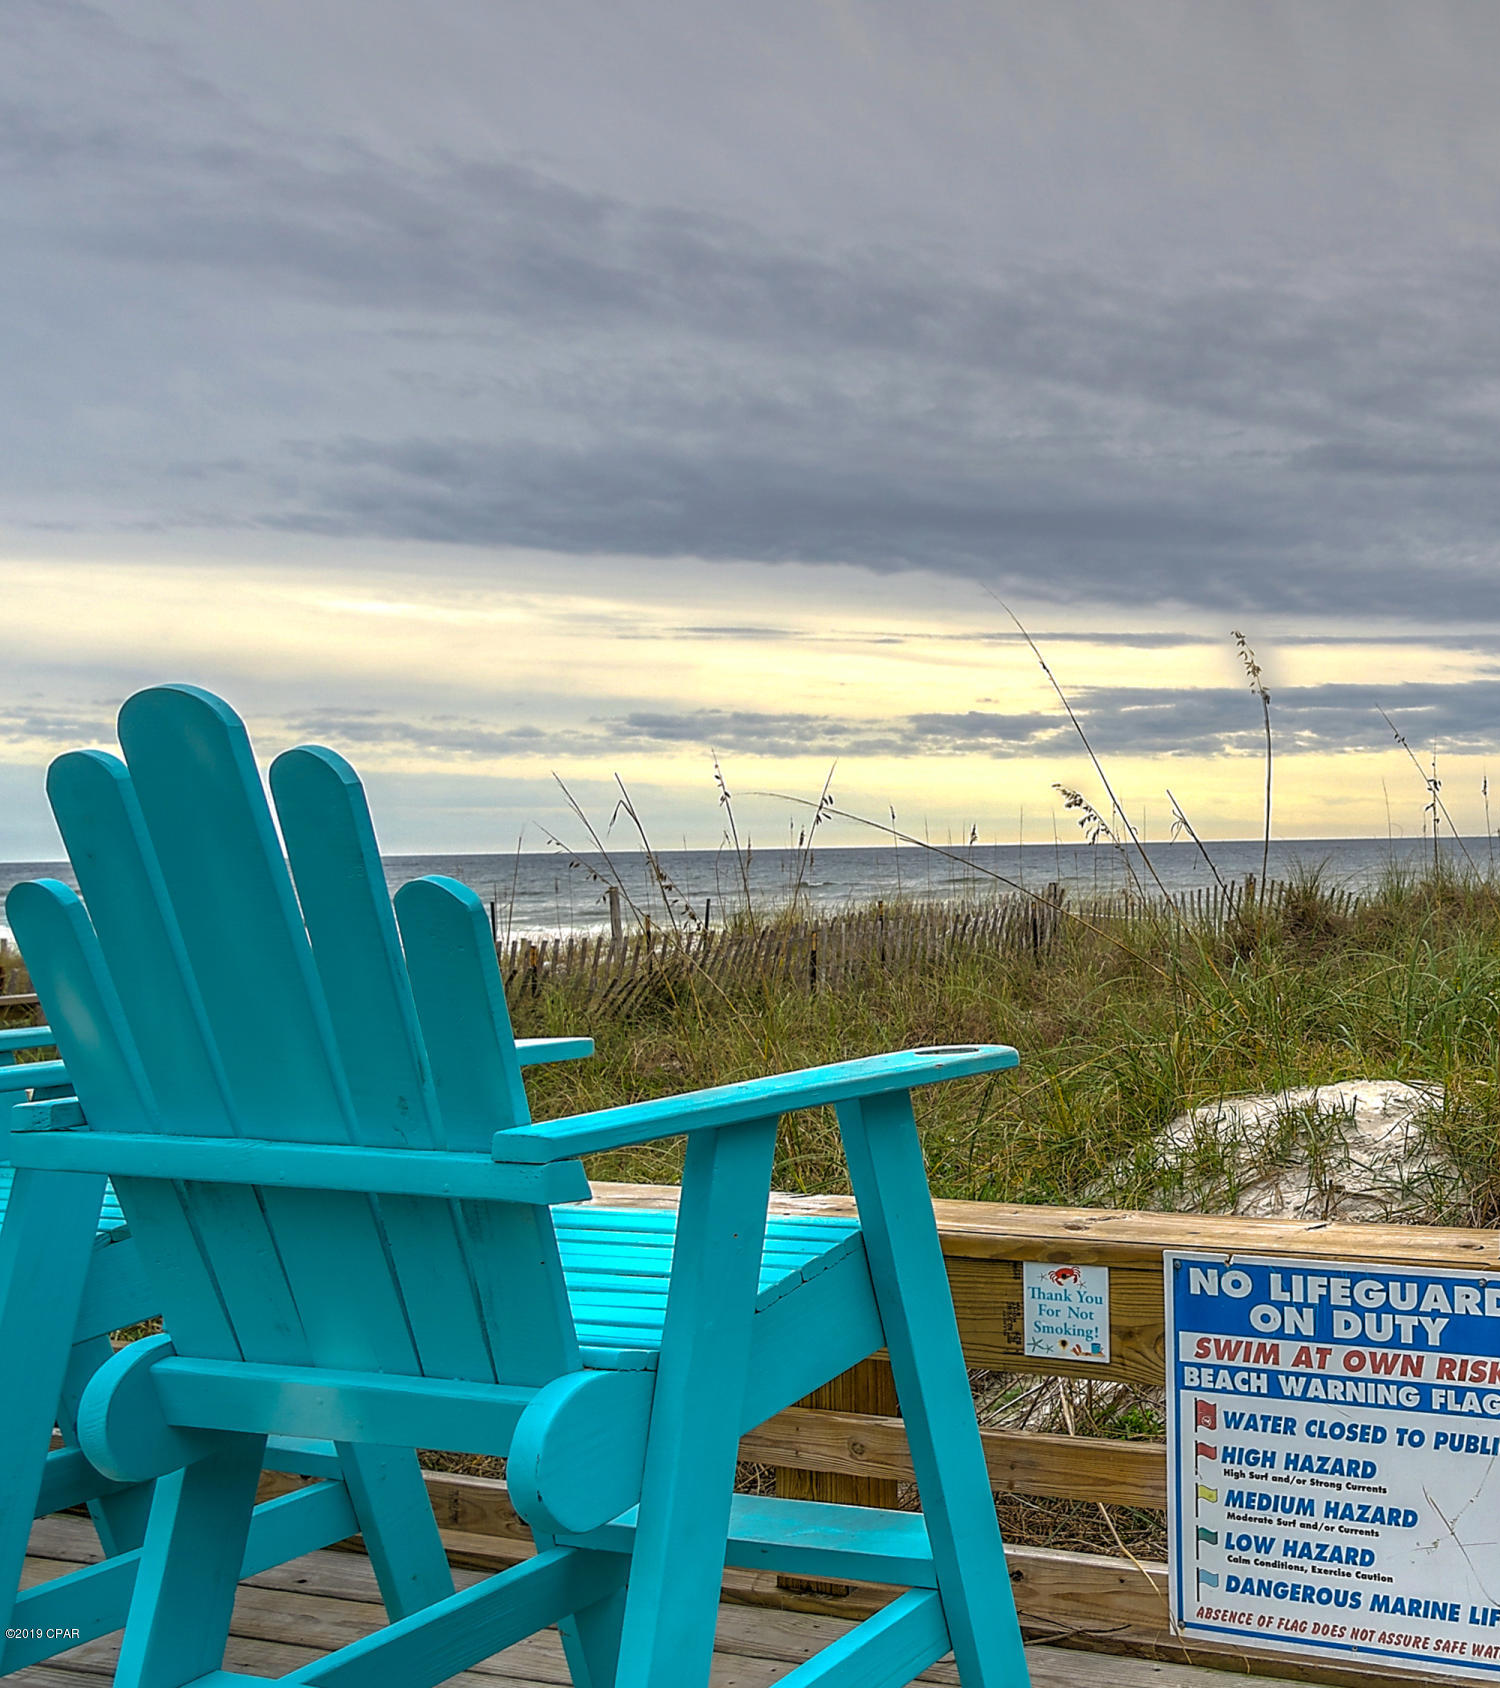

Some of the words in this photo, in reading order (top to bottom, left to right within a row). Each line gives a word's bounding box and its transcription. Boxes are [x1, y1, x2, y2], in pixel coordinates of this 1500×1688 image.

[1027, 1286, 1073, 1303] Thank
[1076, 1290, 1103, 1305] You
[1189, 1267, 1253, 1299] NO
[1038, 1304, 1061, 1317] For
[1067, 1306, 1094, 1321] Not
[1250, 1304, 1314, 1336] ON
[1333, 1310, 1450, 1346] DUTY
[1033, 1320, 1099, 1342] Smoking!
[1194, 1337, 1280, 1366] SWIM
[1291, 1346, 1333, 1370] AT
[1343, 1350, 1425, 1378] OWN
[1184, 1366, 1268, 1394] BEACH
[1278, 1374, 1421, 1408] WARNING
[1223, 1410, 1297, 1436] WATER
[1305, 1419, 1387, 1445] CLOSED
[1396, 1427, 1426, 1448] TO
[1221, 1445, 1277, 1469] HIGH
[1284, 1452, 1377, 1479] HAZARD
[1223, 1468, 1246, 1480] High
[1250, 1471, 1268, 1481] Surf
[1272, 1474, 1307, 1486] and/or
[1310, 1478, 1342, 1491] Strong
[1346, 1482, 1387, 1494] Currents
[1224, 1489, 1315, 1517] MEDIUM
[1324, 1500, 1419, 1528] HAZARD
[1226, 1512, 1274, 1525] Moderate
[1276, 1518, 1296, 1528] Surf
[1299, 1521, 1335, 1533] and/or
[1338, 1525, 1380, 1537] Currents
[1224, 1532, 1276, 1555] LOW
[1282, 1539, 1376, 1567] HAZARD
[1227, 1555, 1250, 1565] Calm
[1254, 1559, 1308, 1574] Conditions,
[1311, 1566, 1352, 1578] Exercise
[1355, 1571, 1393, 1583] Caution
[1225, 1575, 1362, 1610] DANGEROUS
[1369, 1594, 1461, 1623] MARINE
[1196, 1606, 1253, 1626] ABSENCE
[1257, 1615, 1274, 1628] OF
[1277, 1617, 1308, 1633] FLAG
[1311, 1622, 1347, 1638] DOES
[1350, 1627, 1376, 1642] NOT
[1378, 1631, 1431, 1650] ASSURE
[1433, 1639, 1468, 1655] SAFE
